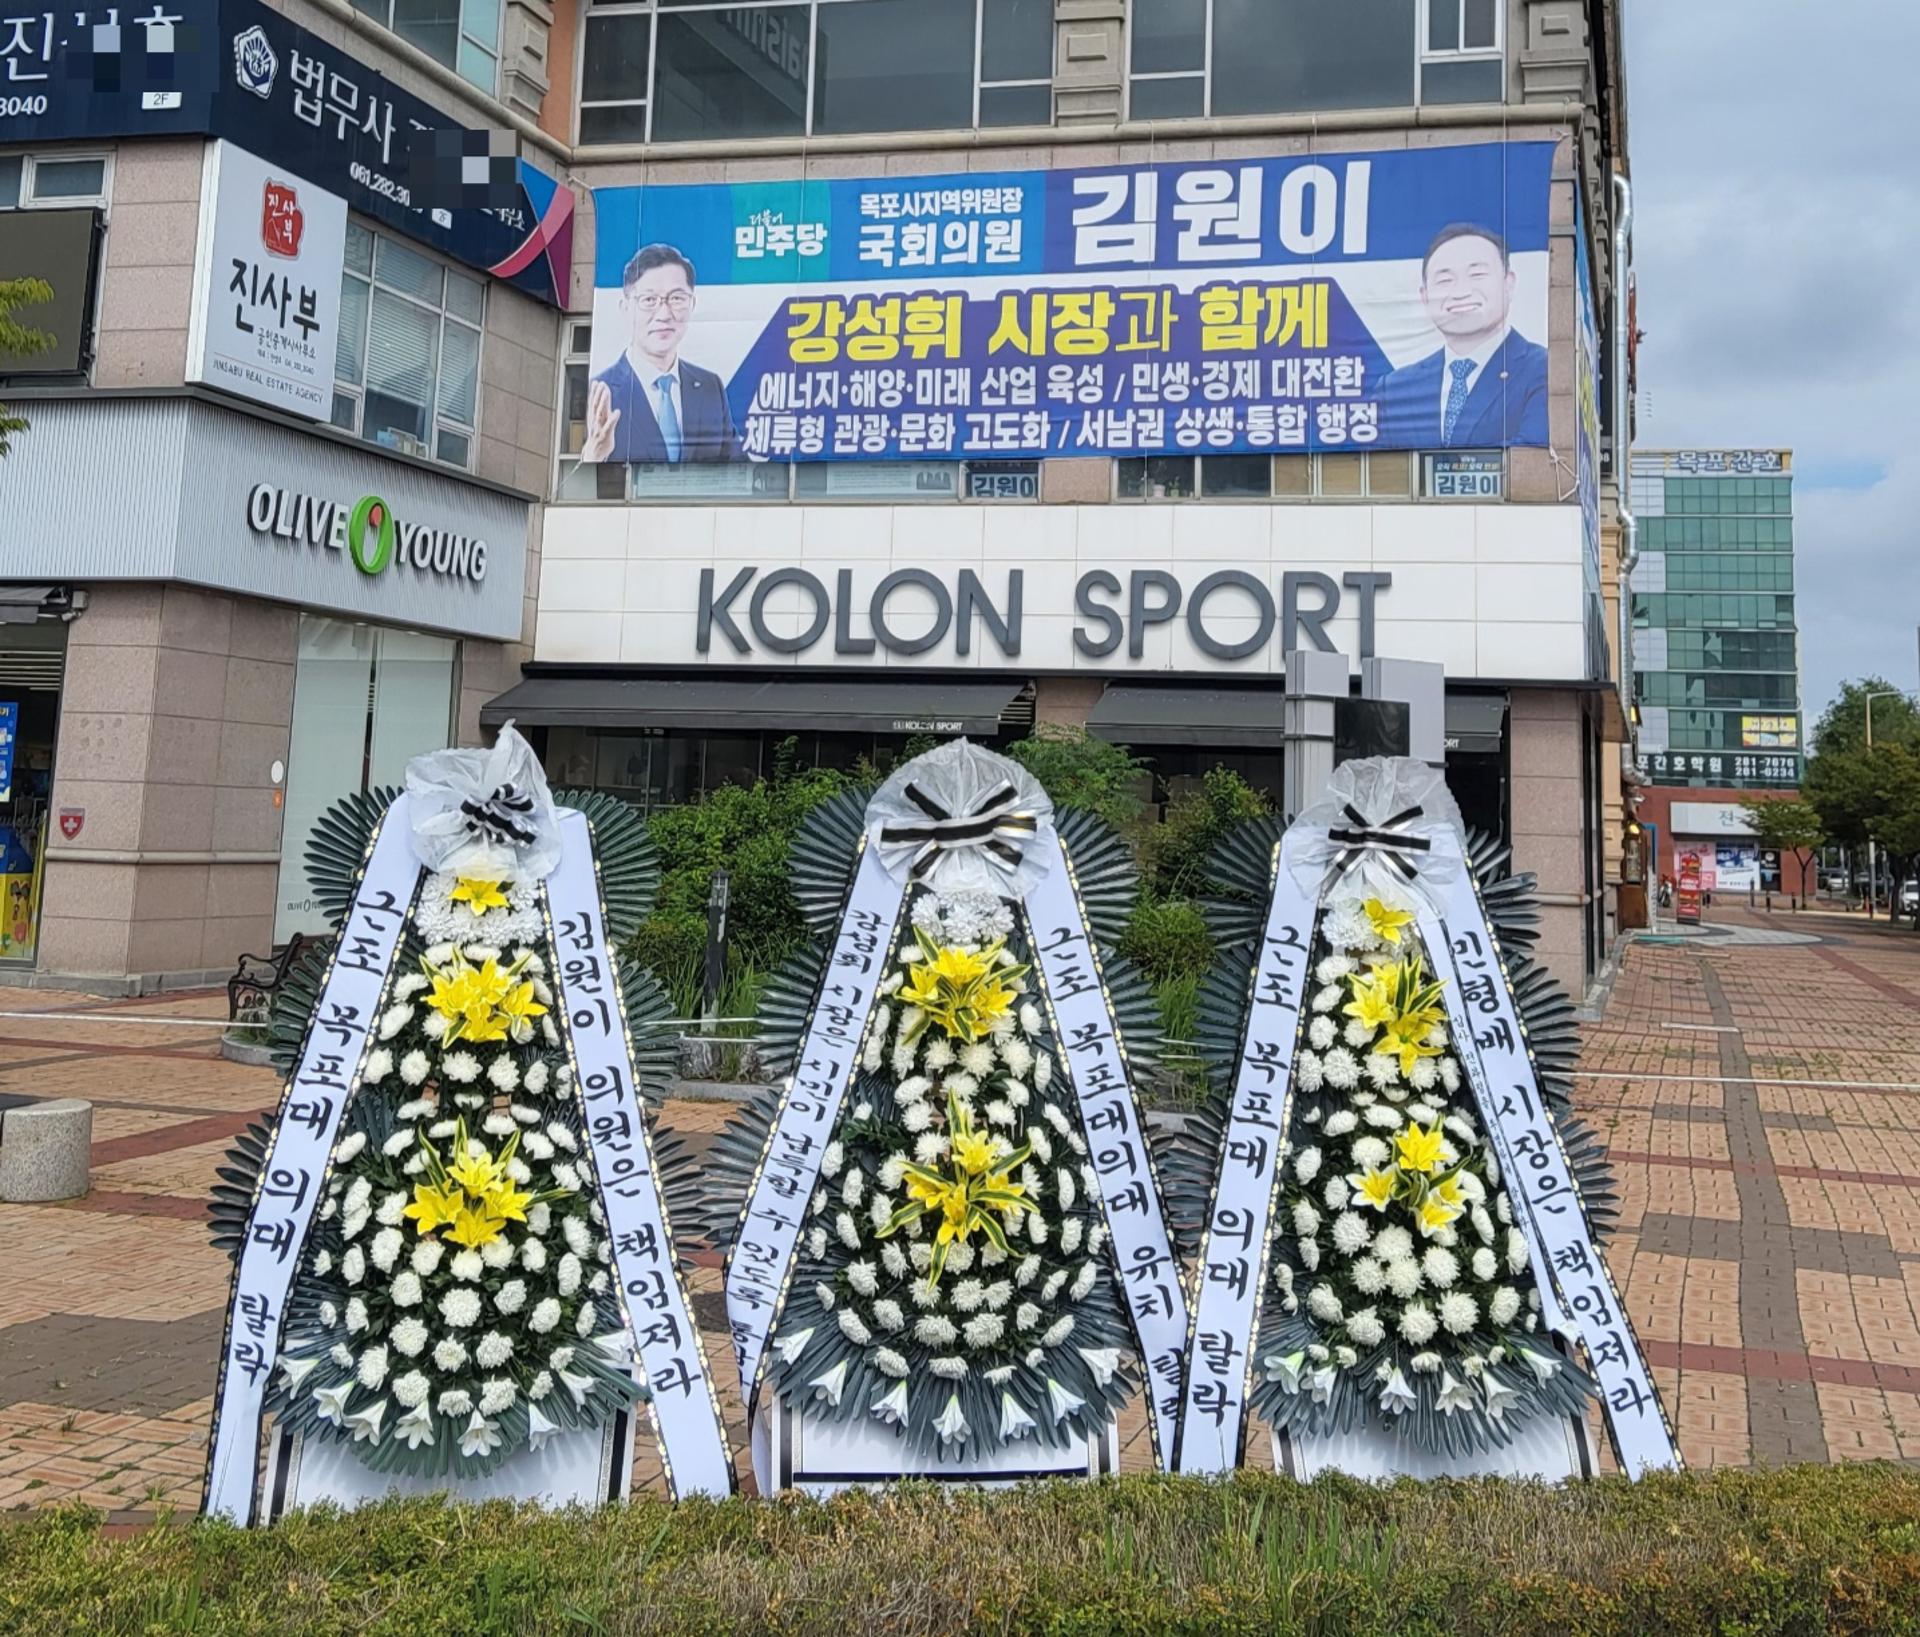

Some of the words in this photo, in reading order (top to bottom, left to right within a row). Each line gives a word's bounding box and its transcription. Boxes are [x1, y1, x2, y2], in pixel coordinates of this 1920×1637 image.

[152, 94, 169, 107] 2F
[291, 49, 396, 164] 법무사
[734, 222, 828, 259] 민주당
[749, 208, 783, 227] 더불어
[858, 218, 1023, 268] 국회의원
[860, 187, 1024, 219] 목포시지역위원장
[1072, 160, 1372, 266] 김원이
[229, 257, 321, 341] 진사부
[787, 295, 963, 364] 강성휘
[988, 289, 1179, 357] 시장과
[1200, 282, 1329, 351] 함께
[245, 370, 264, 386] REAL
[266, 377, 294, 395] ESTATE
[295, 385, 324, 404] AGENCY
[759, 367, 971, 410] 에너지·해양·미래
[980, 366, 1037, 406] 산업
[1047, 362, 1103, 404] 육성
[1132, 360, 1260, 402] 민생·경제
[1271, 356, 1365, 398] 대전환
[742, 414, 825, 455] 체류형
[834, 411, 956, 453] 관광·문화
[963, 410, 1051, 450] 고도화
[1076, 407, 1165, 449] 서남권
[1174, 403, 1307, 446] 상생·통합
[1316, 402, 1378, 444] 행정
[1437, 474, 1498, 496] 김원이
[248, 482, 348, 549] OLIVE
[395, 519, 488, 581] YOUNG
[695, 565, 1023, 657] KOLON
[1071, 567, 1393, 661] SPORT
[905, 720, 935, 731] KOLON
[935, 721, 963, 732] SPORT
[337, 889, 405, 978] 근조
[558, 911, 611, 1037] 김원이
[1039, 926, 1099, 1002] 근조
[1254, 925, 1308, 1012] 근조
[288, 1002, 367, 1141] 목포대
[1227, 1040, 1289, 1179] 목포대
[585, 1065, 650, 1198] 의원은
[1066, 1022, 1150, 1217] 목포대의대
[253, 1167, 311, 1264] 의대
[1452, 930, 1515, 1056] 민형배
[1499, 1084, 1573, 1214] 시장은
[1553, 1239, 1653, 1419] 책임져라
[1124, 1245, 1174, 1320] 유치
[1207, 1207, 1255, 1302] 의대
[233, 1292, 277, 1388] 탈락
[616, 1222, 702, 1398] 책임져라
[1191, 1329, 1243, 1428] 탈락
